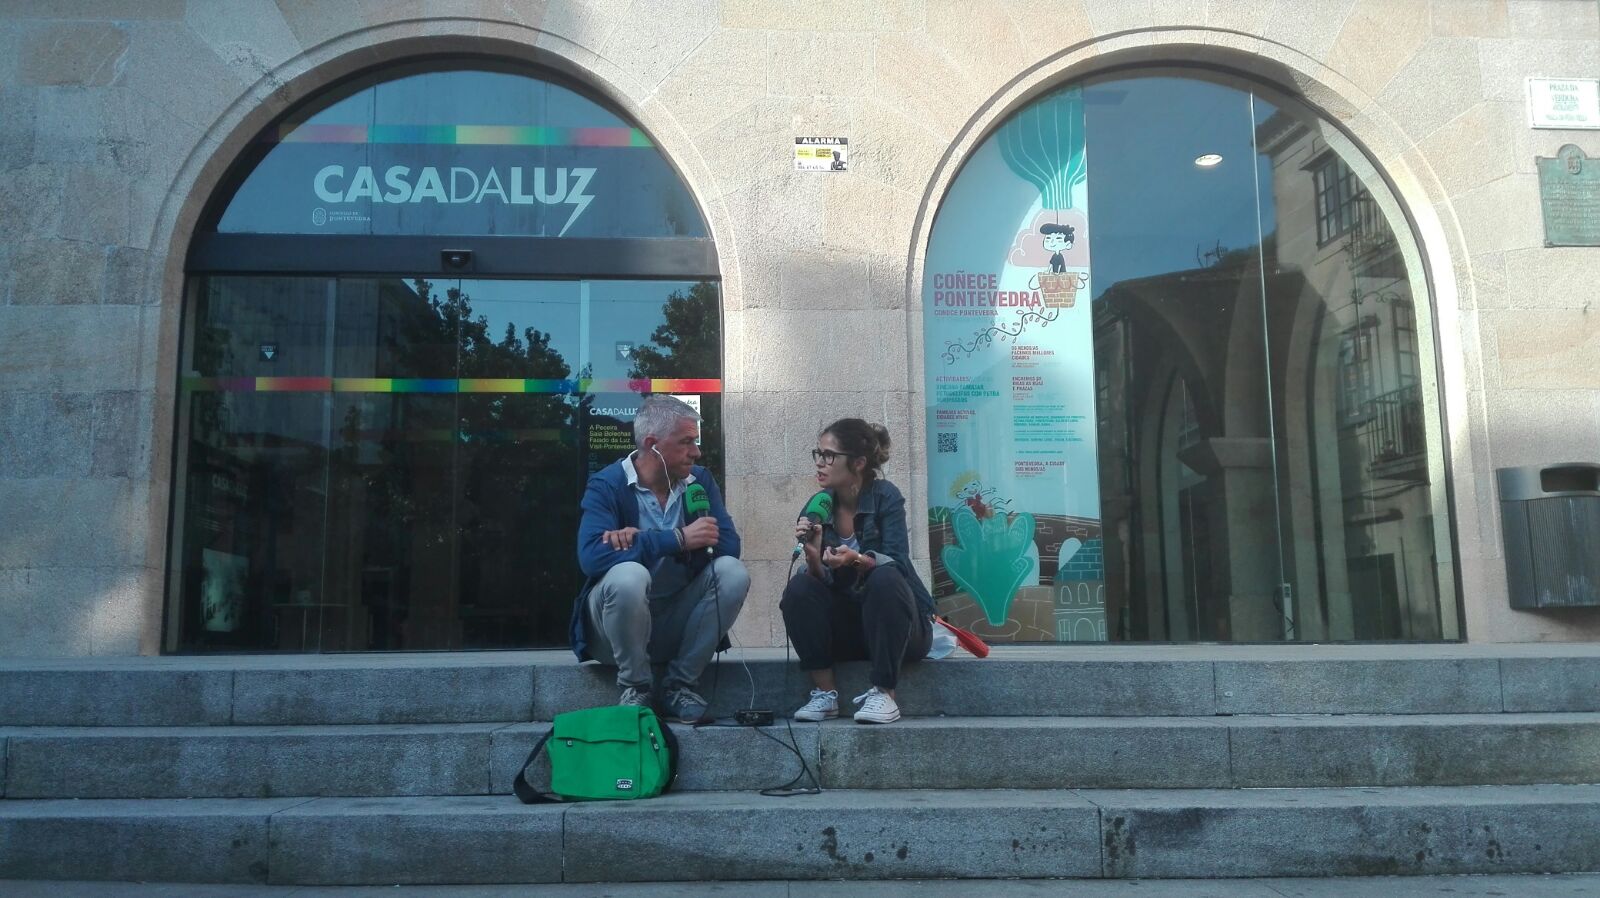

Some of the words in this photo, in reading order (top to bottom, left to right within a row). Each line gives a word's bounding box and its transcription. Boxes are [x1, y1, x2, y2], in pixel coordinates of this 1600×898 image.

[801, 137, 841, 145] ALARMA
[312, 165, 598, 237] CASADALUZ
[933, 270, 998, 290] COÑECE
[934, 291, 1042, 307] PONTEVEDRA
